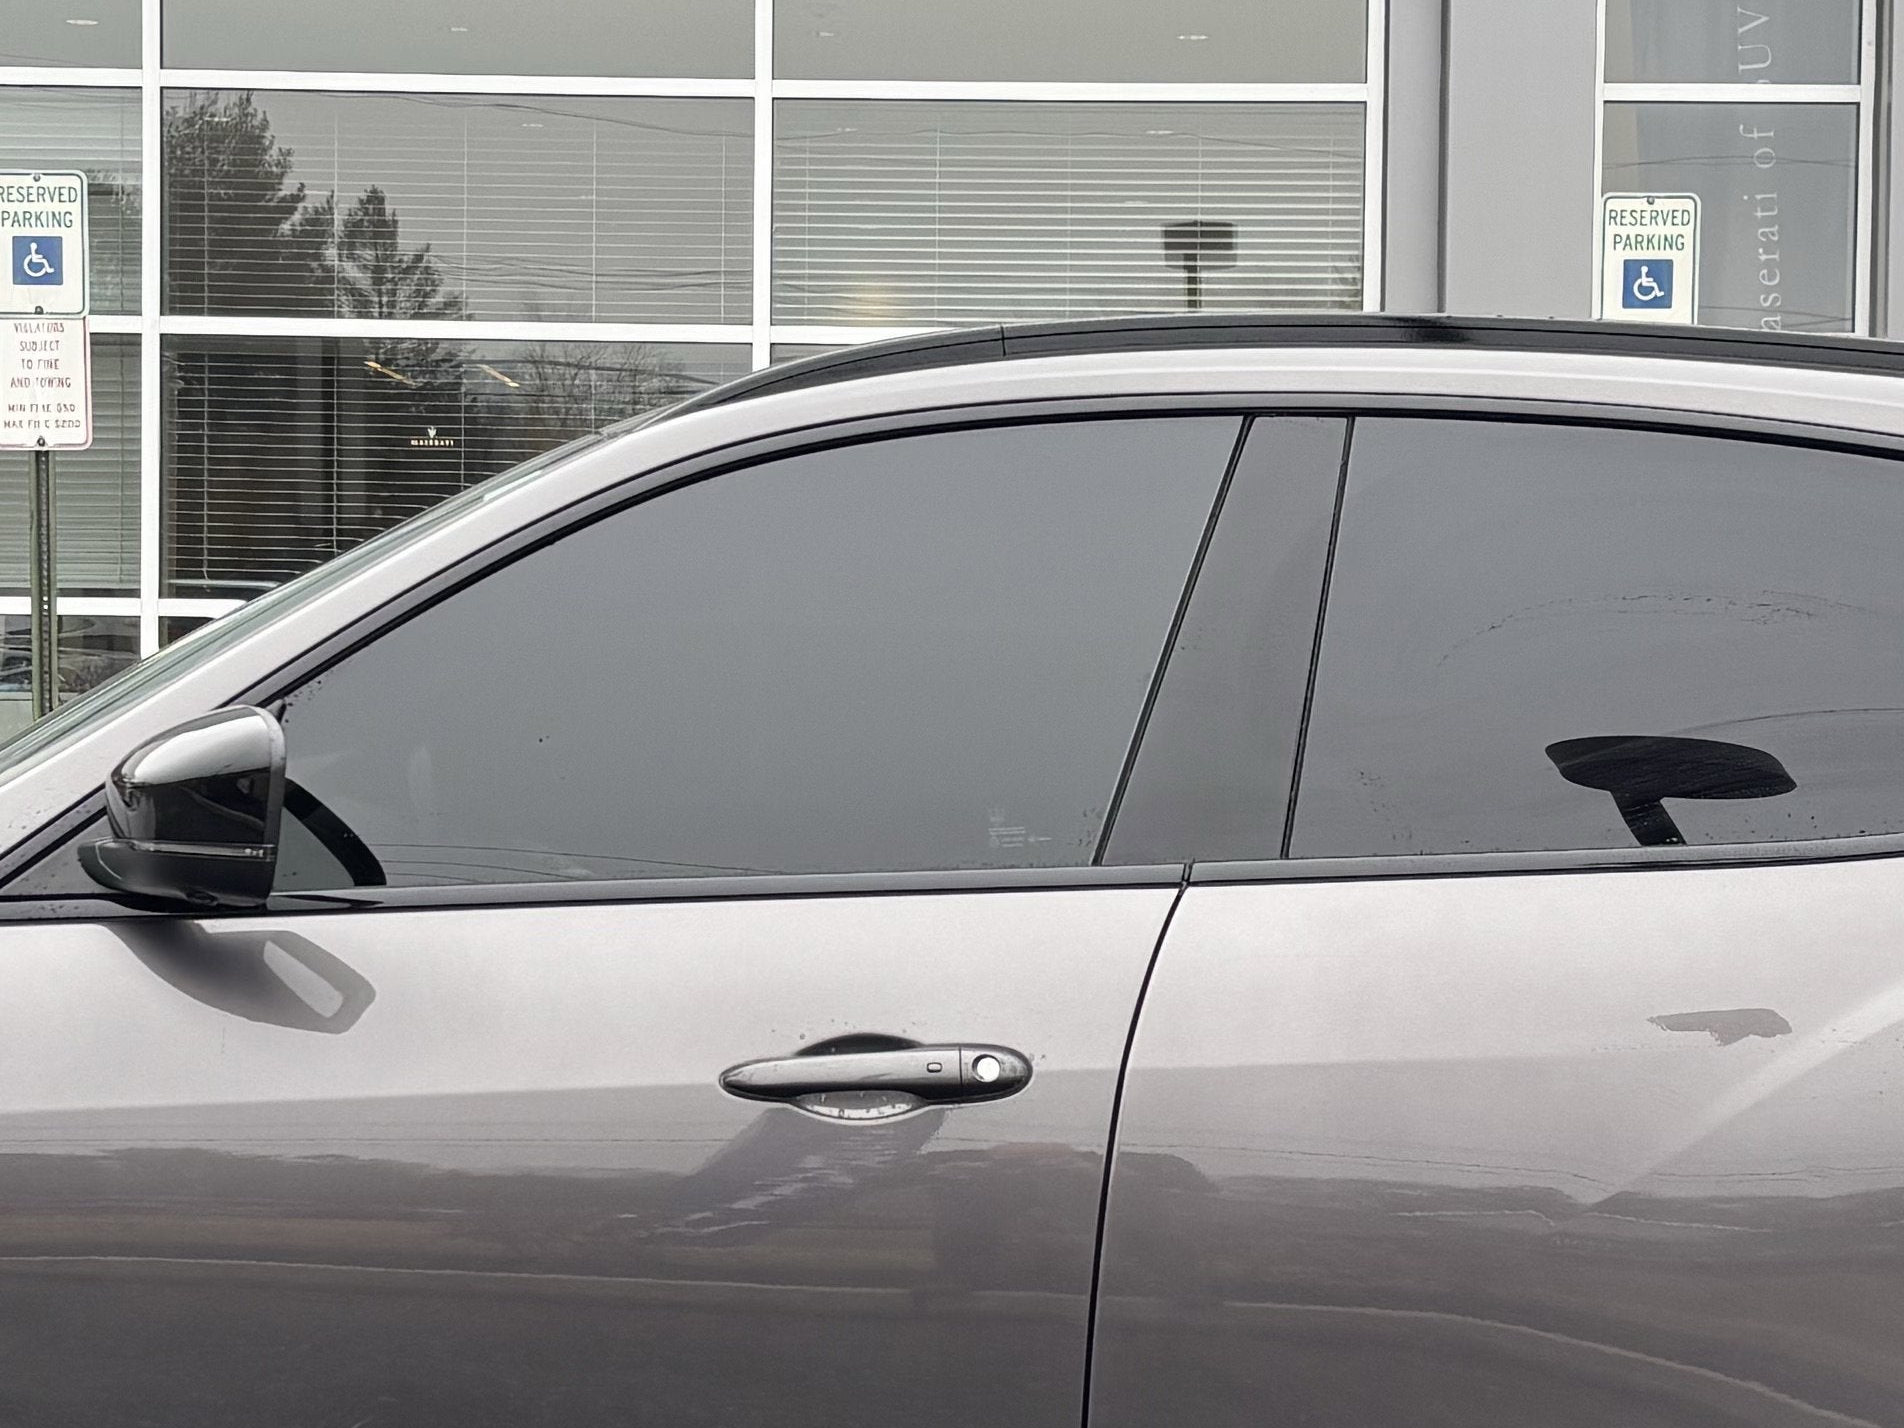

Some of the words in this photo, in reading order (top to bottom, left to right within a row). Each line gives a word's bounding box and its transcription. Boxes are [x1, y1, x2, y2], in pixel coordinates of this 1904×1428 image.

[1739, 123, 1776, 169] of
[0, 210, 74, 228] PARKING
[1608, 209, 1691, 226] RESERVED
[1613, 233, 1685, 251] PARKING
[1743, 191, 1782, 331] aserati
